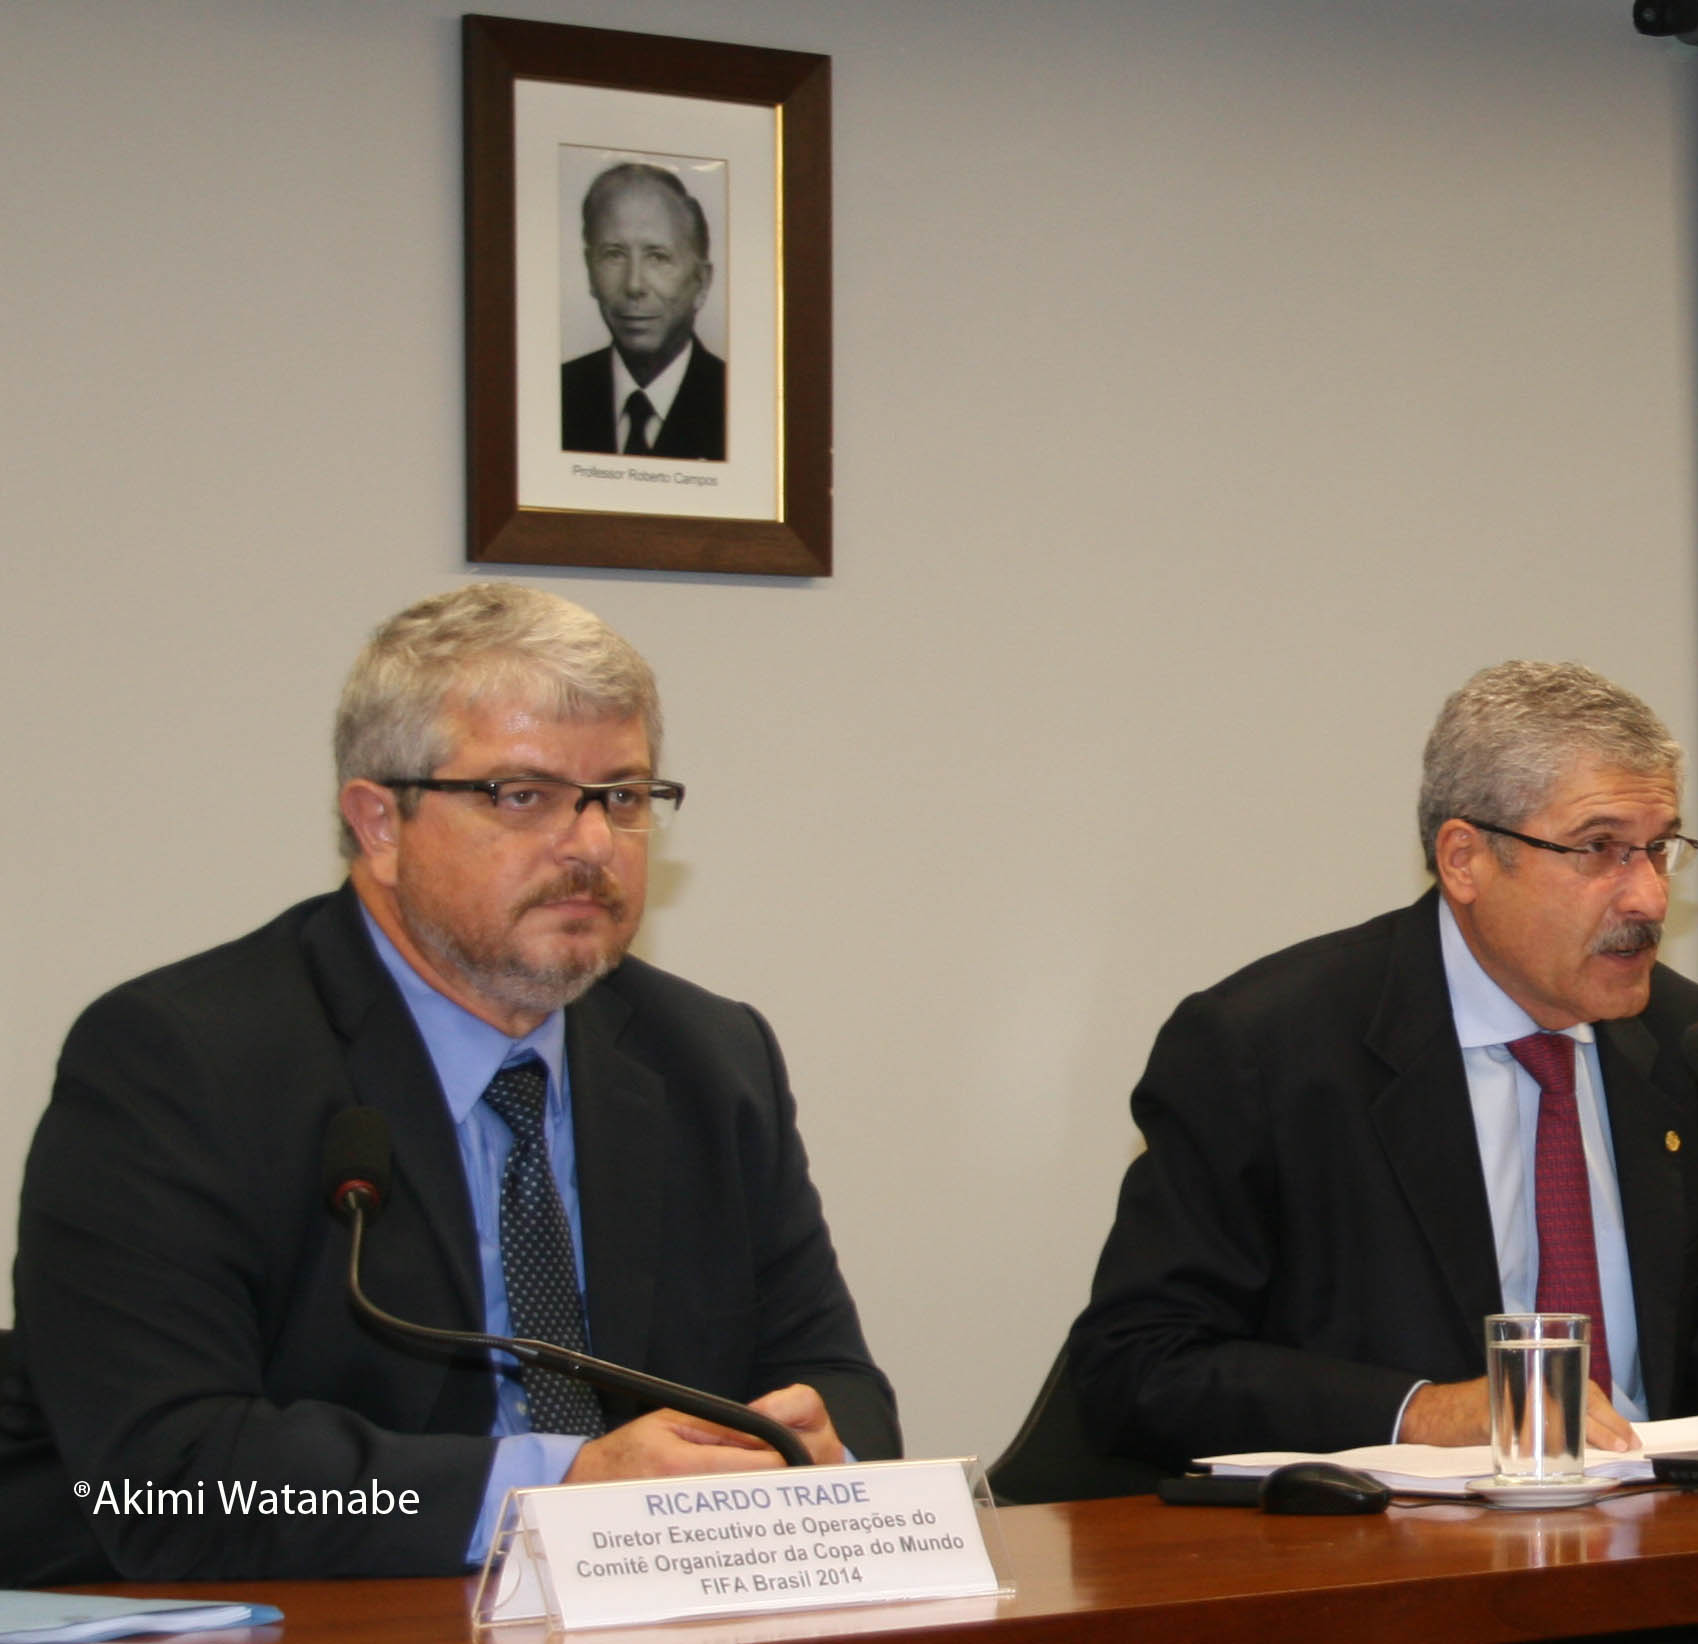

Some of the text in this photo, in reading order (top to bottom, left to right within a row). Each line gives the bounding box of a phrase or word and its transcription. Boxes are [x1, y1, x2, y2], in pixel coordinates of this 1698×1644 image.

[673, 472, 718, 487] Campos
[646, 1481, 870, 1516] RICARDO TRADE
[592, 1508, 936, 1551] Diretor Executivo de Operações do
[577, 1532, 964, 1579] Comitê Organizador da Copa do Mundo
[701, 1565, 862, 1596] FIFA Brasil 2014
